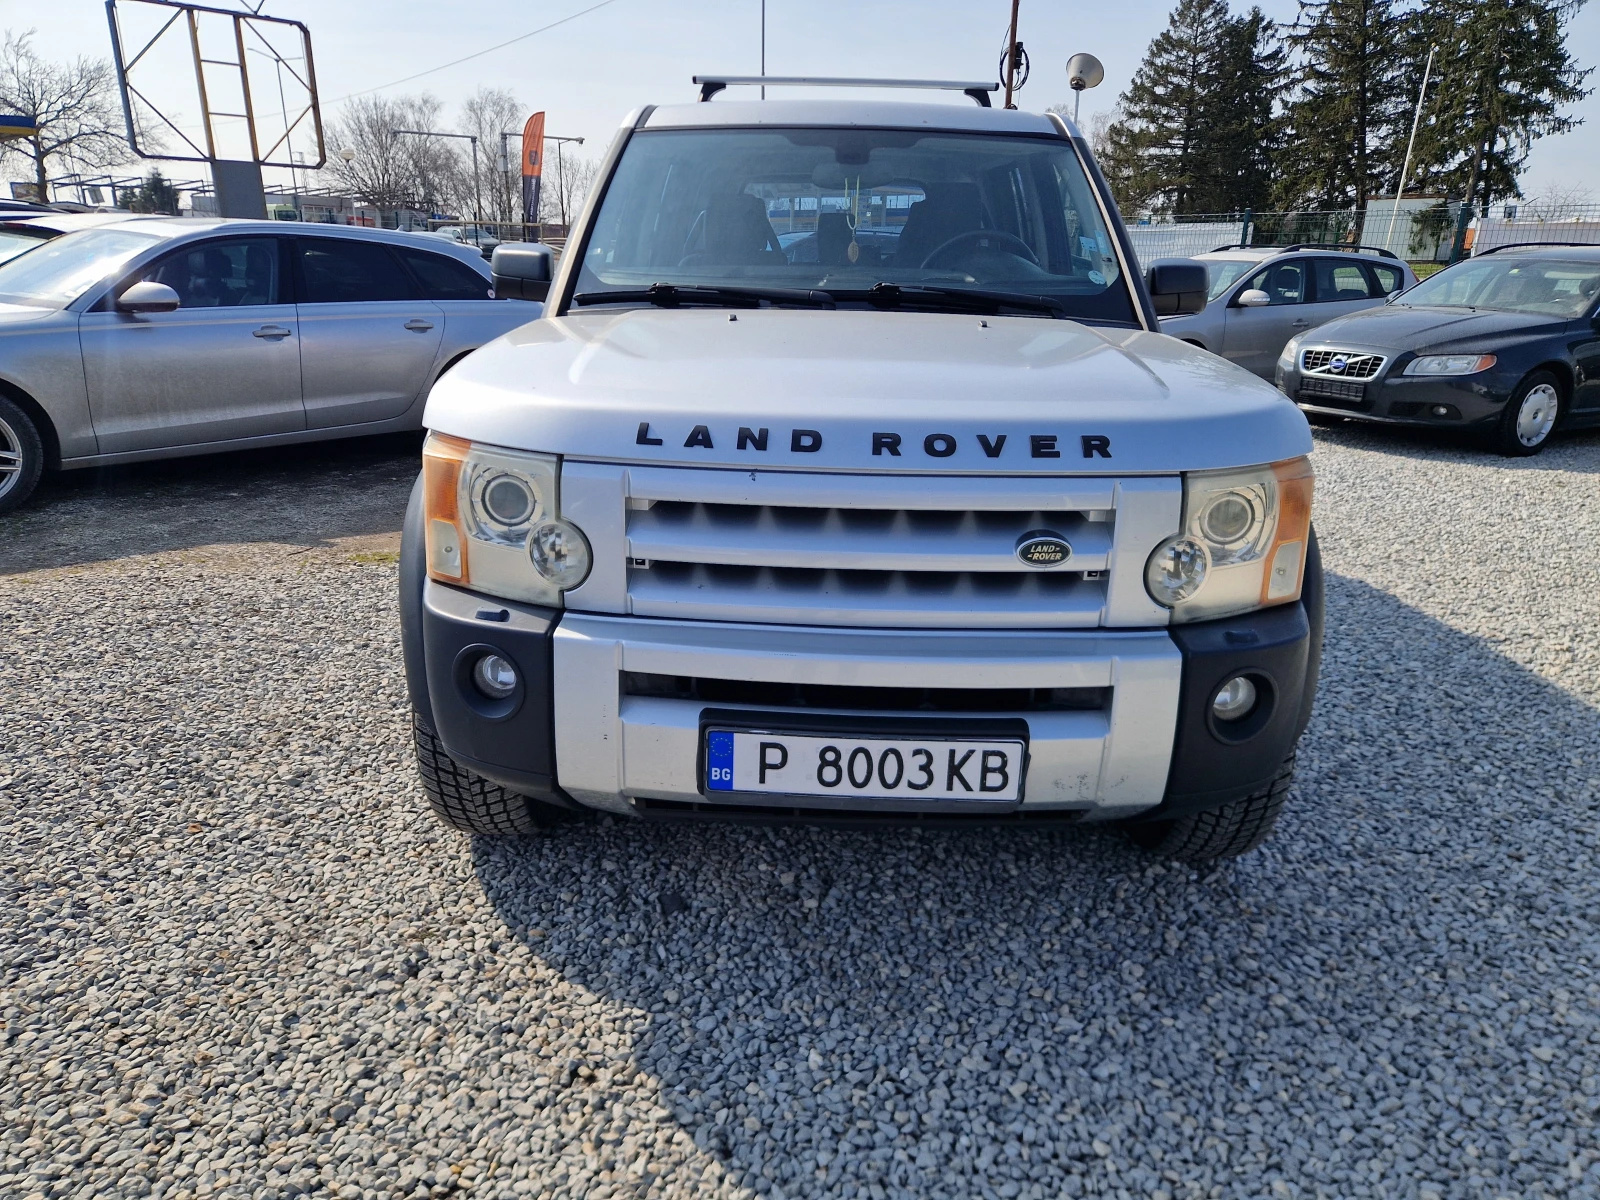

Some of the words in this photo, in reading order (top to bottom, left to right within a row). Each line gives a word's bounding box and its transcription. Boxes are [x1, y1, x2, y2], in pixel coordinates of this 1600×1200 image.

[635, 421, 823, 453] LAND
[871, 431, 1112, 458] ROVER
[1030, 545, 1055, 553] LAND
[1032, 552, 1062, 560] ROVER
[758, 741, 788, 784] P
[711, 767, 731, 781] BG
